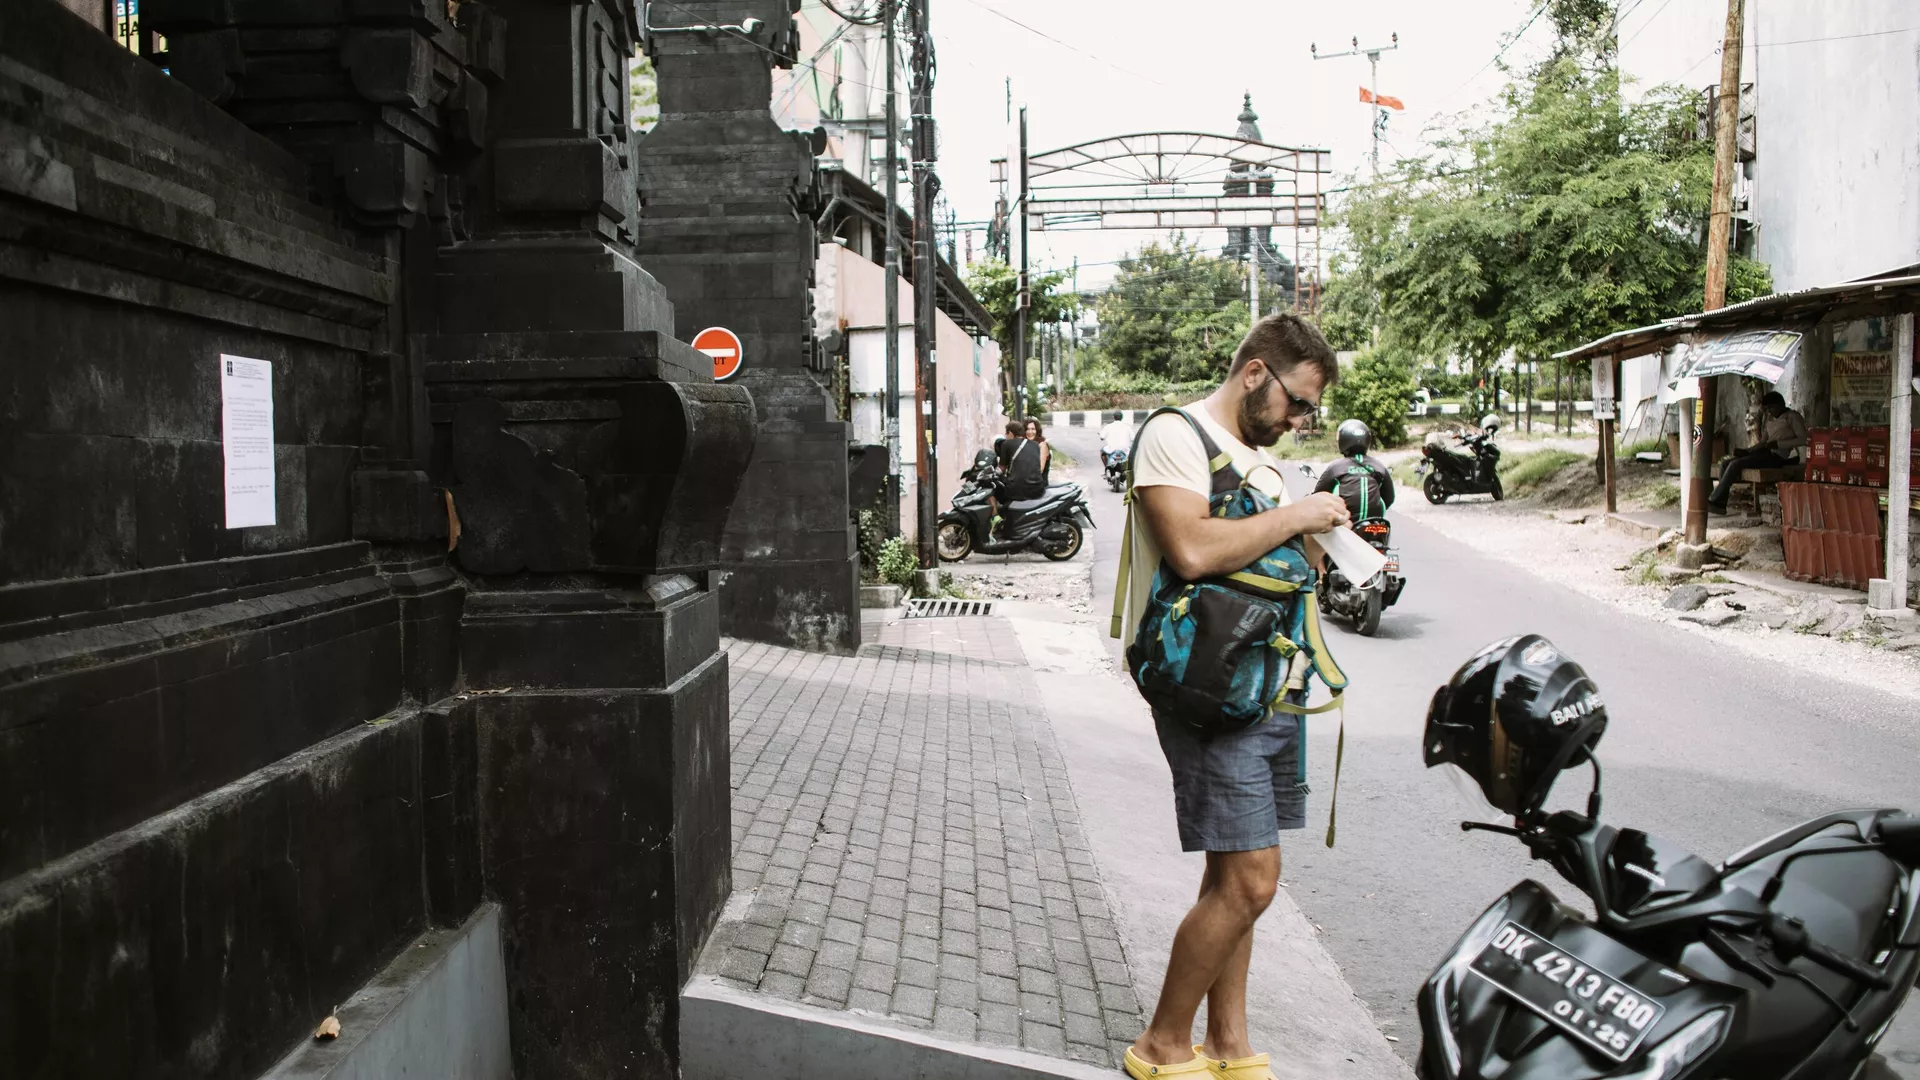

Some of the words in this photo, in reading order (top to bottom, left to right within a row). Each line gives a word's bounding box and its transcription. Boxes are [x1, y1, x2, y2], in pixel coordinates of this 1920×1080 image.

[1834, 355, 1860, 374] HOUSE
[1861, 355, 1878, 374] FOR
[1491, 925, 1535, 960] DK
[1532, 951, 1602, 998] 4213
